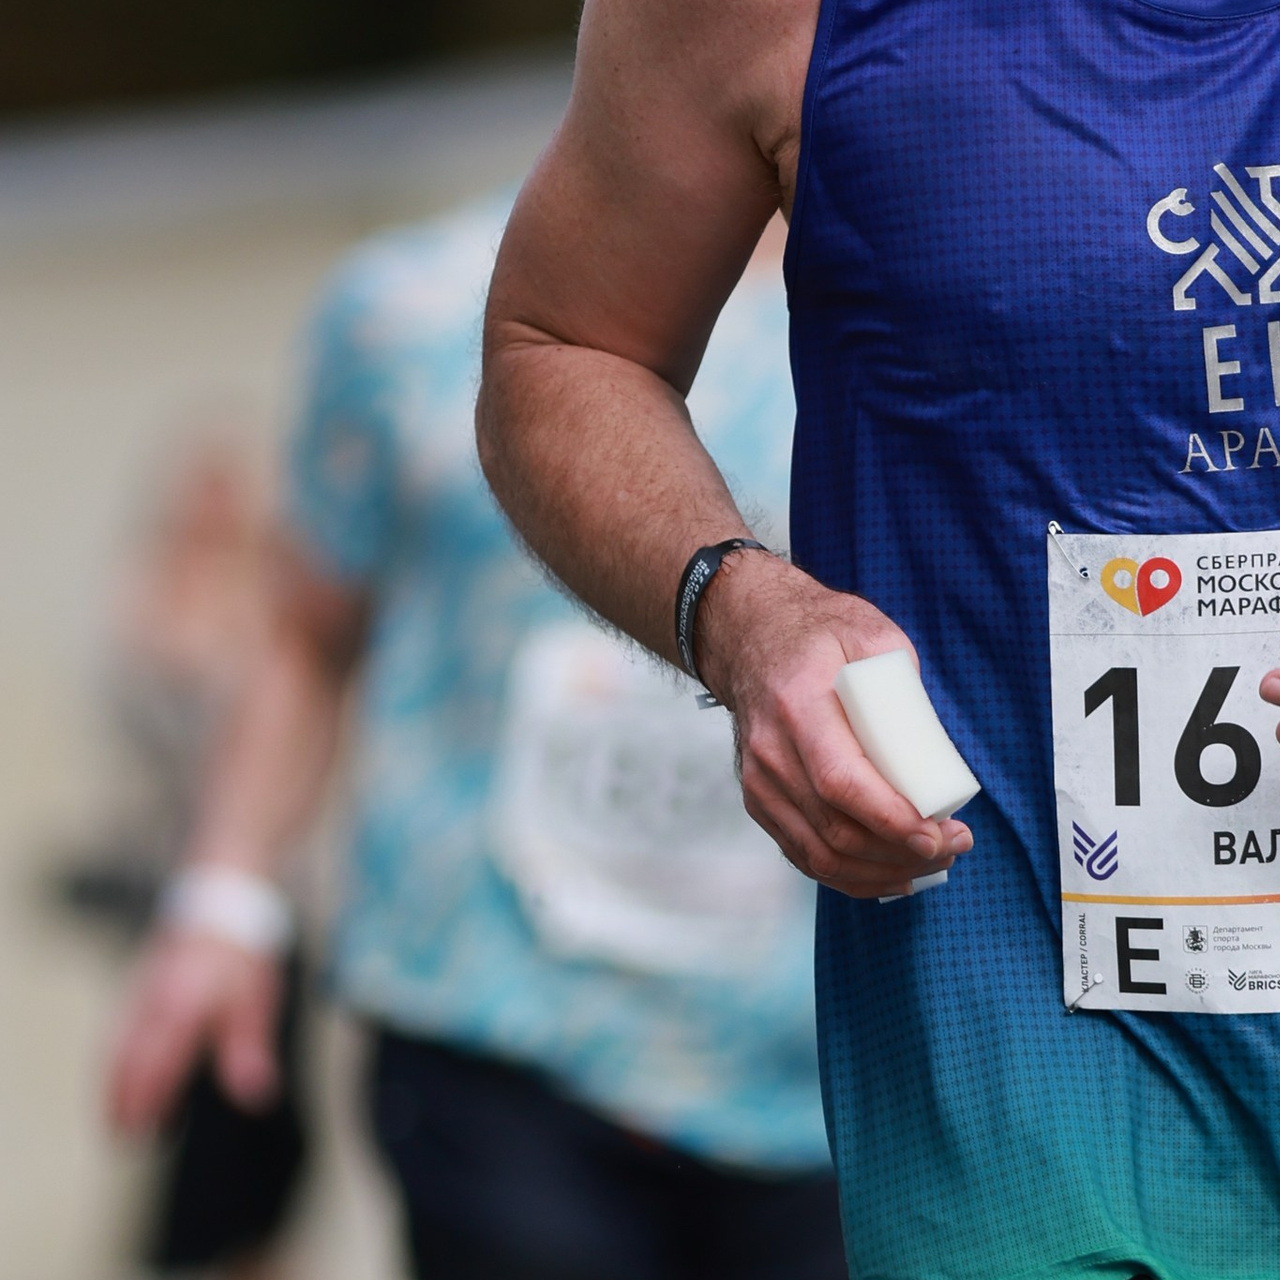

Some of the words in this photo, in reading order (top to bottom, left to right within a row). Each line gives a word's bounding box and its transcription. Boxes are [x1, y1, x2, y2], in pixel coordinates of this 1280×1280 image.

[1079, 913, 1087, 947] CORRAL
[1213, 926, 1263, 934] Департамент
[1115, 916, 1167, 995] E
[1242, 943, 1272, 951] Москвы
